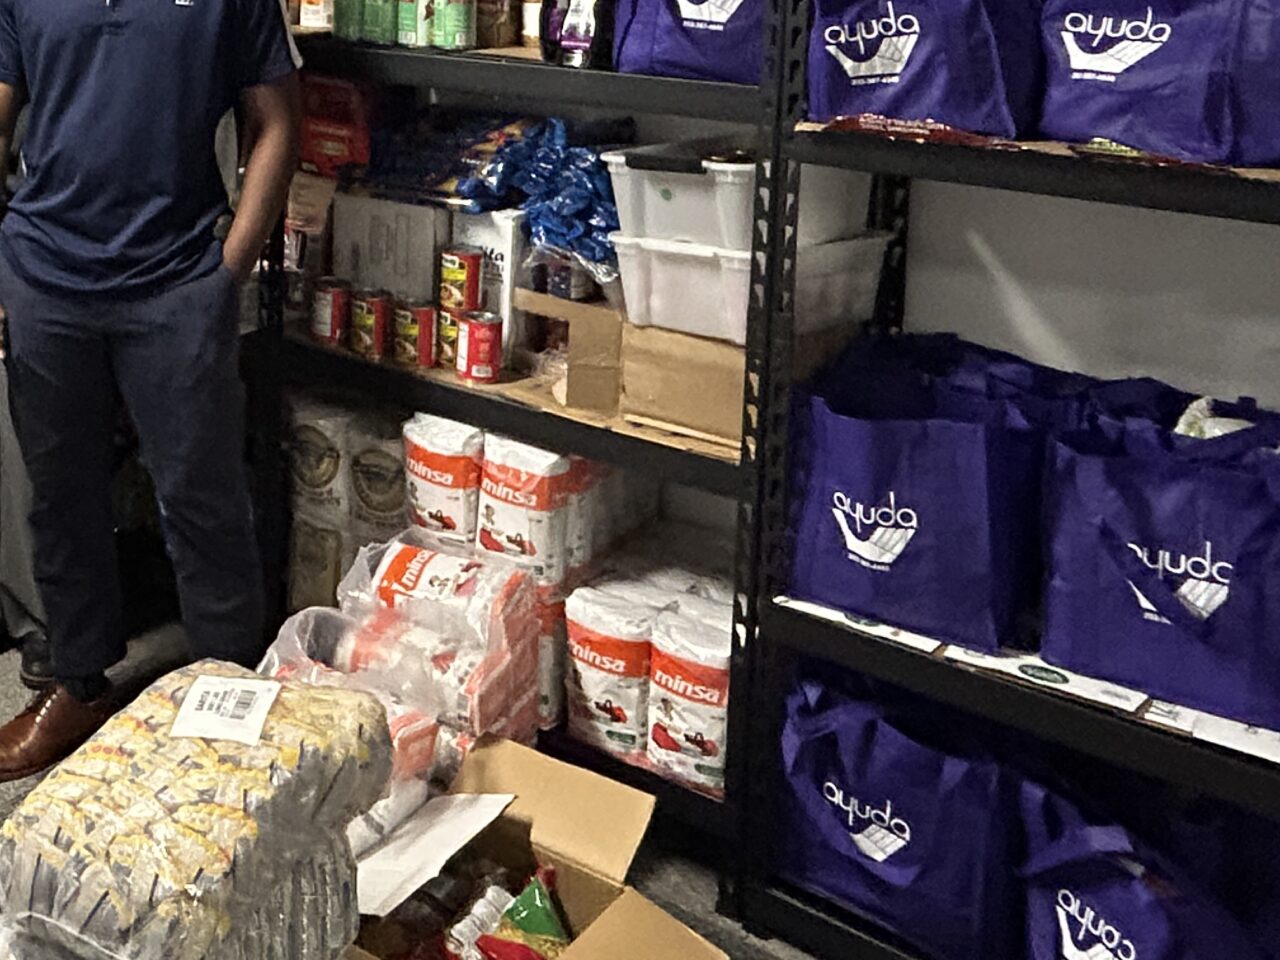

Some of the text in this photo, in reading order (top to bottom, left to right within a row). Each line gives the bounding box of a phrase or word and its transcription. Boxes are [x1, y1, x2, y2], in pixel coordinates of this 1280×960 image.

[823, 0, 921, 55] ayuda
[1063, 5, 1172, 47] ayuda
[406, 457, 454, 486] minsa
[481, 477, 538, 507] minsa
[833, 491, 919, 534] ayuda
[568, 640, 627, 673] minsa
[653, 668, 720, 703] minsa
[822, 781, 911, 842] ayuda
